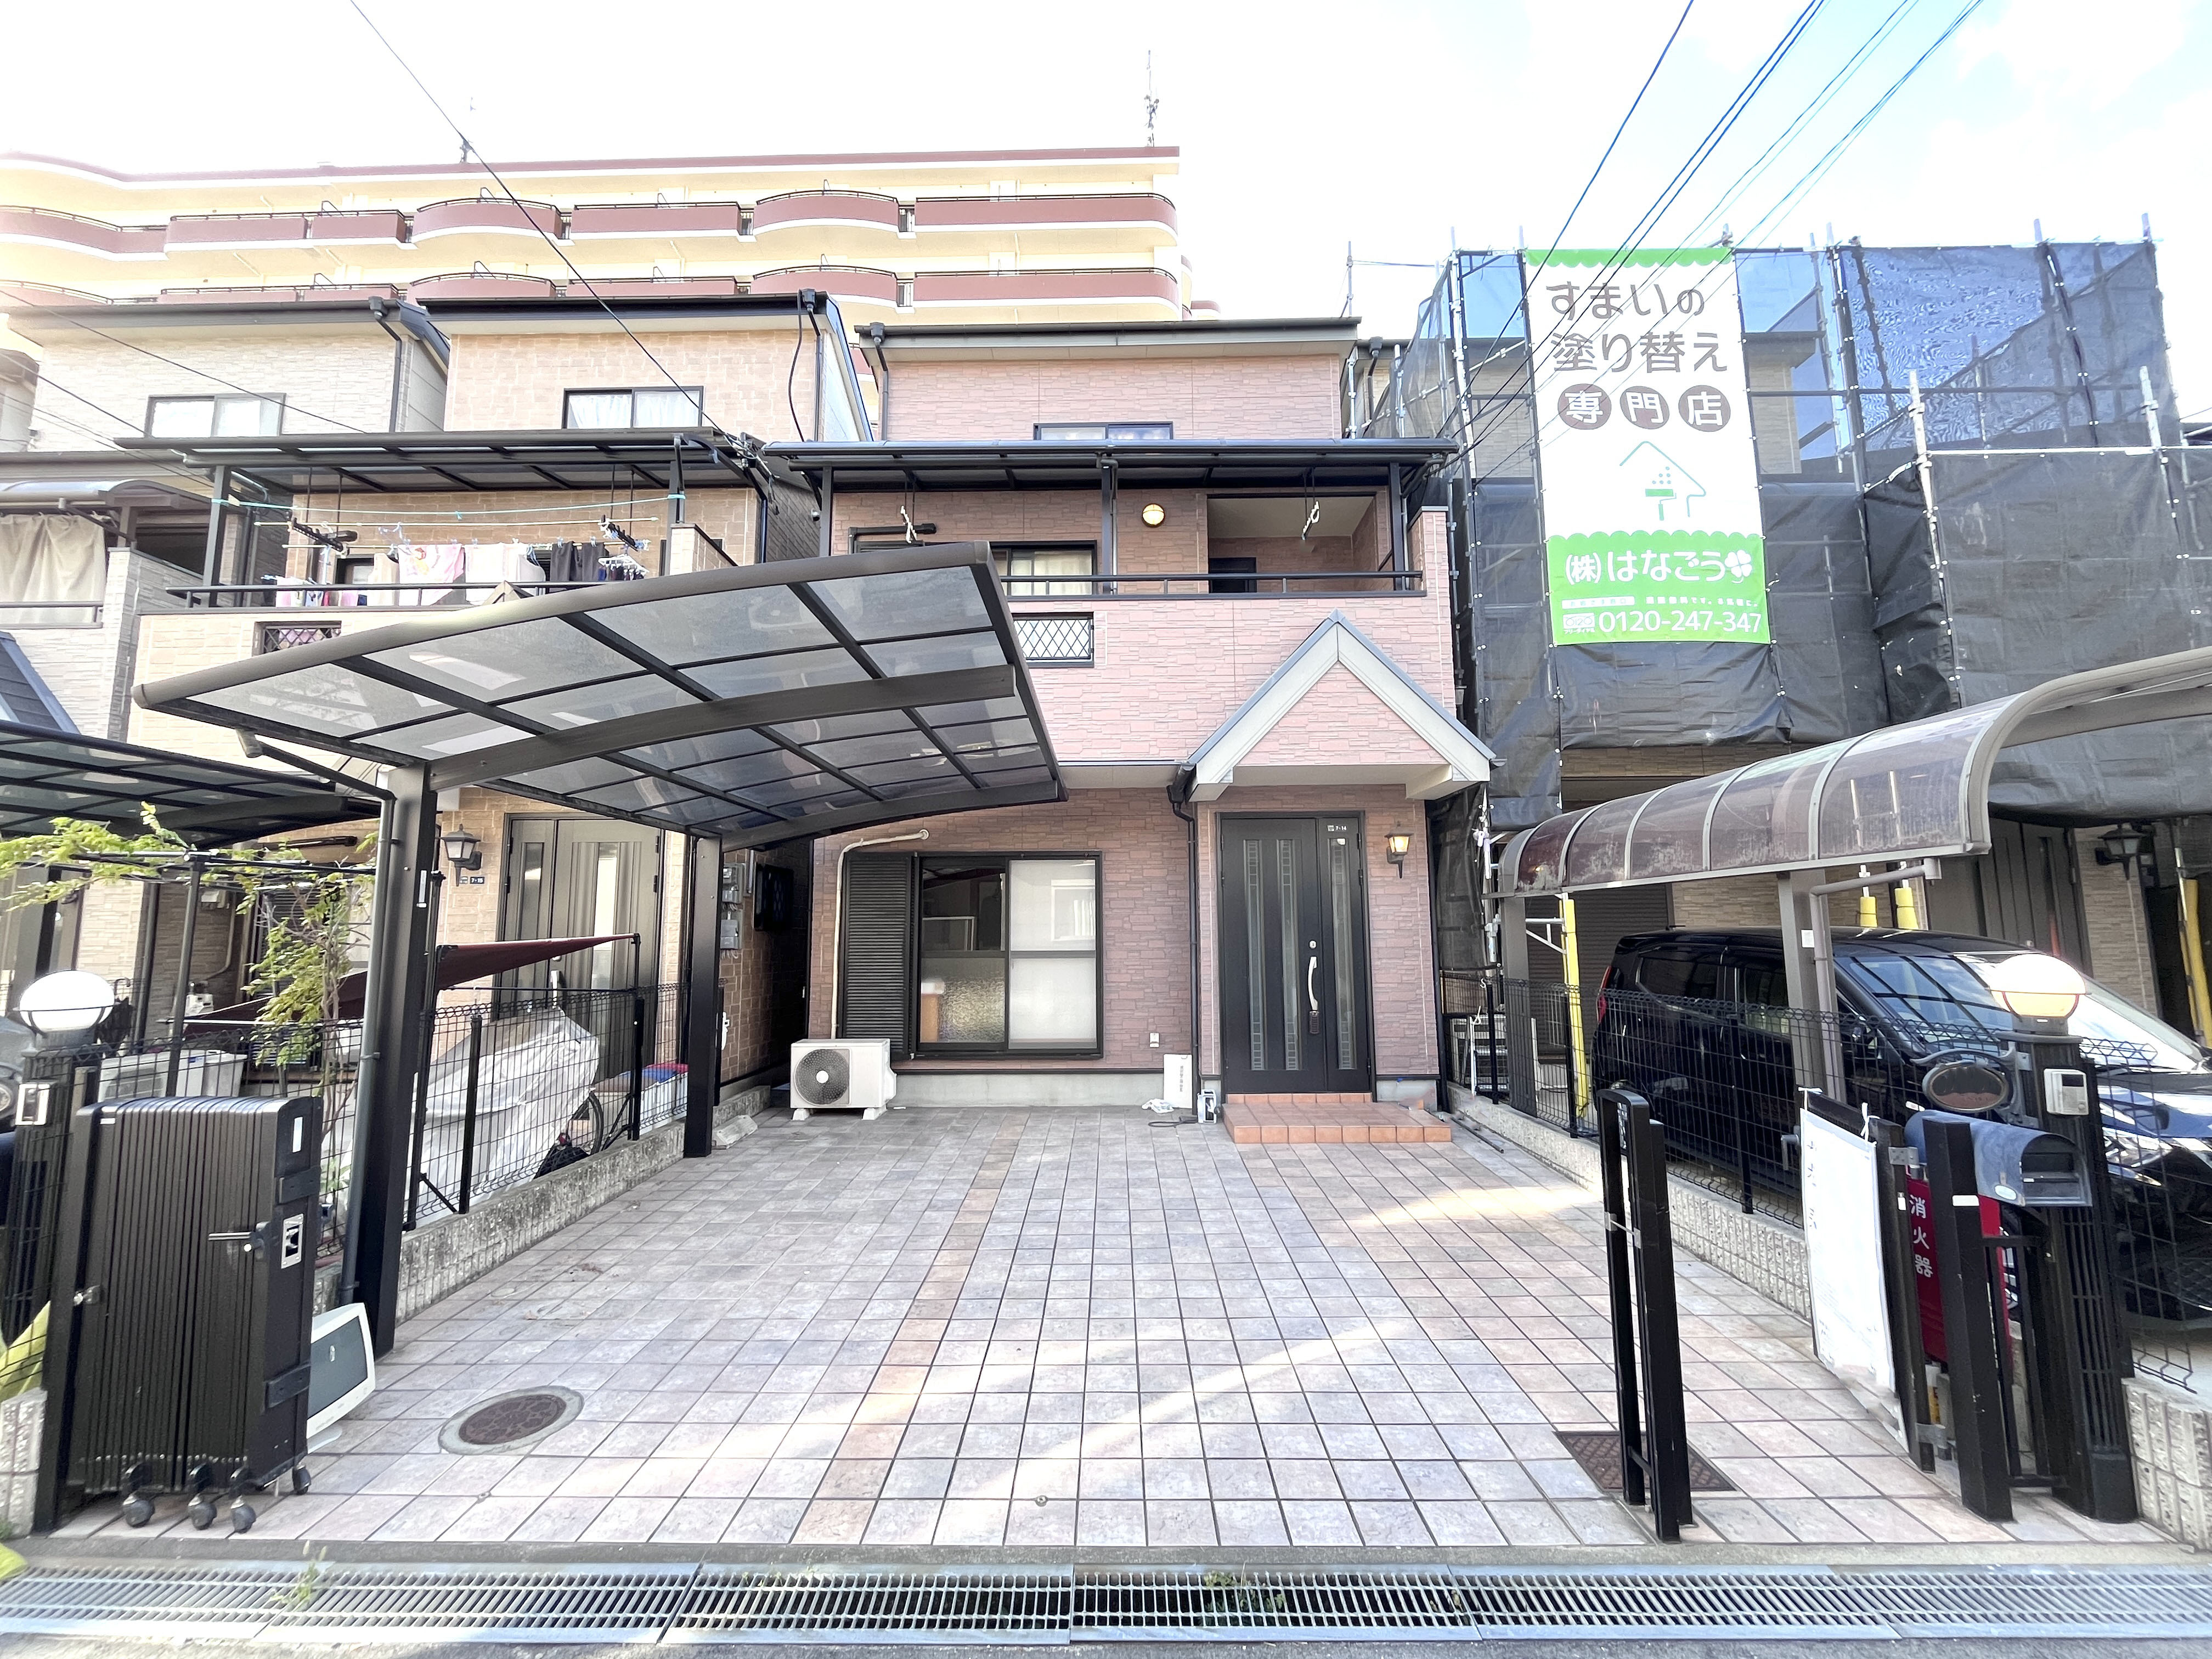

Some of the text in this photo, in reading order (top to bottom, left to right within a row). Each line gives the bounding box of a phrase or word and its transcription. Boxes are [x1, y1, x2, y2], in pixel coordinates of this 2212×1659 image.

[1545, 280, 1705, 321] すまいの
[1550, 331, 1728, 374] 塗り替え
[1564, 390, 1724, 426] 専門店
[1598, 610, 1762, 633] 0120-247-347
[1909, 1194, 1934, 1278] 消火器
